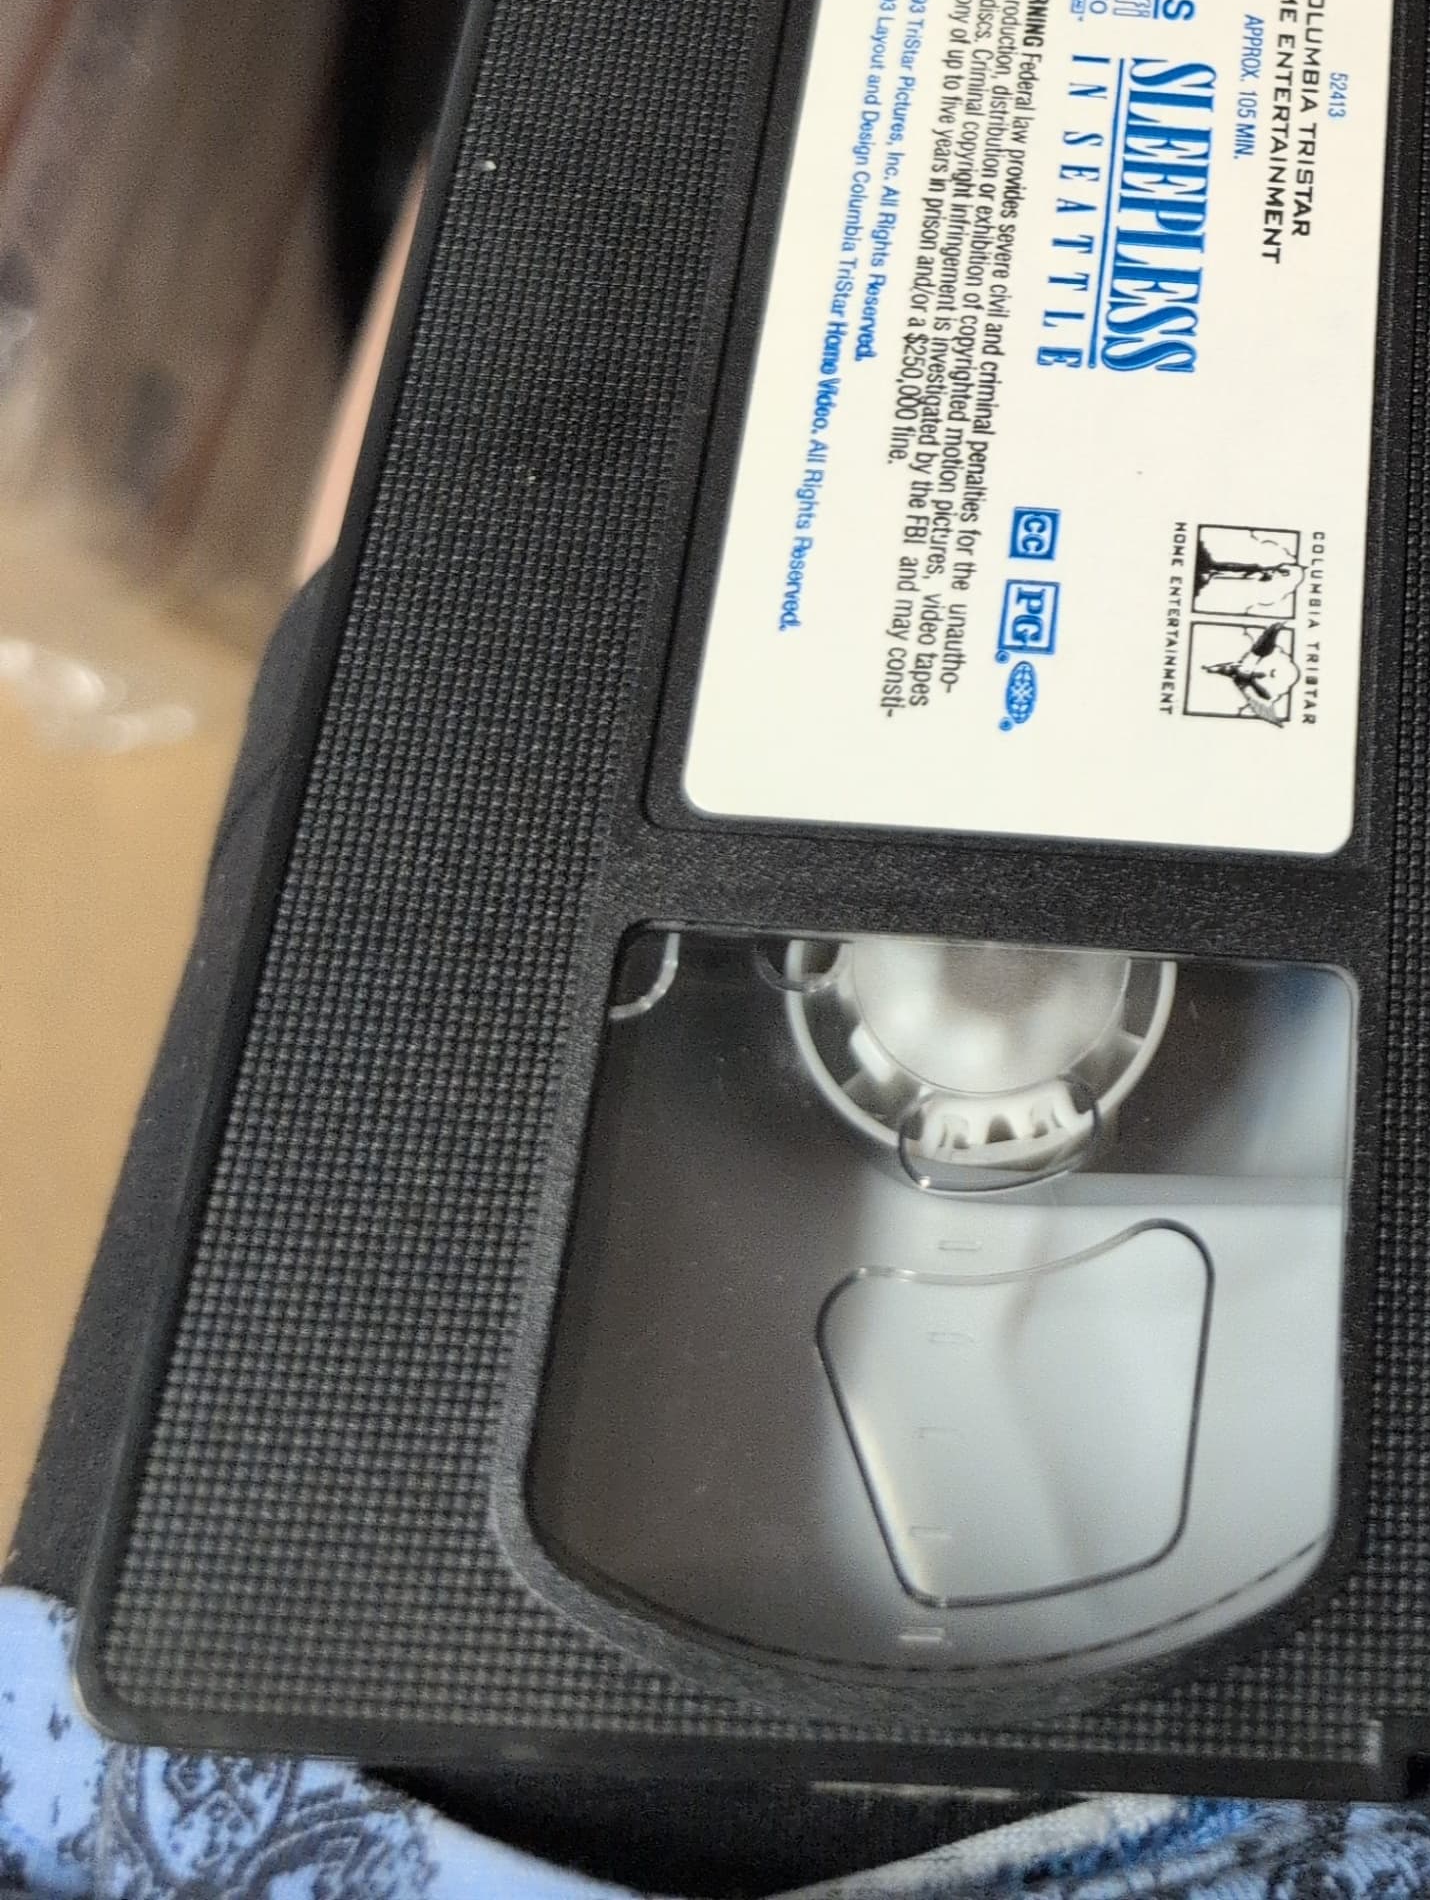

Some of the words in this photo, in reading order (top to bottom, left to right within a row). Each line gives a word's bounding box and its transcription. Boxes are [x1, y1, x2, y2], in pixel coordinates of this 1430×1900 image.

[869, 15, 894, 70] Layout
[900, 18, 924, 70] TriStar
[940, 48, 964, 69] up
[948, 27, 971, 44] of
[1240, 13, 1264, 81] APPROX.
[863, 73, 881, 105] and
[941, 74, 965, 90] to
[963, 48, 994, 116] Criminal
[1014, 52, 1042, 111] Federal
[1068, 54, 1110, 98] IN
[1327, 71, 1348, 118] 52413
[885, 75, 916, 145] Pictures,
[937, 95, 963, 124] five
[980, 84, 1013, 178] distribution
[1009, 115, 1034, 144] law
[1236, 91, 1258, 118] 105
[851, 109, 880, 165] Design
[930, 128, 953, 173] years
[948, 120, 979, 198] copyright
[1233, 122, 1256, 159] MIN.
[1261, 33, 1295, 264] ENTERTAINMENT
[883, 151, 905, 180] Inc.
[927, 177, 953, 192] in
[977, 182, 996, 201] or
[999, 148, 1027, 219] provides
[1290, 122, 1317, 236] TRISTAR
[840, 170, 870, 252] Columbia
[879, 185, 900, 207] All
[1099, 57, 1216, 373] SLEEPLESS
[870, 211, 897, 267] Rights
[918, 196, 947, 253] prison
[963, 204, 997, 286] exhibition
[991, 223, 1016, 279] severe
[1036, 130, 1103, 368] SEATTLE
[909, 254, 937, 313] and/or
[931, 202, 974, 311] infringement
[829, 257, 857, 318] TriStar
[961, 292, 985, 310] of
[986, 283, 1012, 318] civil
[854, 273, 886, 361] Reserved.
[906, 316, 926, 327] a
[932, 316, 957, 331] is
[981, 322, 1005, 356] and
[819, 321, 848, 375] Home
[893, 331, 930, 420] $250,000
[939, 314, 978, 422] copyrighted
[811, 377, 839, 434] Video.
[912, 335, 956, 446] investigated
[971, 360, 1002, 435] criminal
[806, 438, 828, 463] All
[887, 425, 916, 467] fine.
[907, 451, 939, 475] by
[937, 426, 968, 493] motion
[795, 468, 824, 530] Rights
[907, 479, 934, 509] the
[955, 439, 988, 522] penalties
[902, 514, 930, 544] FBI
[921, 498, 958, 579] pictures,
[955, 528, 982, 556] for
[1170, 521, 1187, 566] HOME
[778, 535, 812, 631] Reserved.
[896, 555, 920, 592] and
[950, 561, 977, 591] the
[1307, 530, 1325, 628] COLUMBIA
[884, 598, 913, 641] may
[916, 593, 946, 646] video
[1158, 575, 1182, 715] ENTERTAINMENT
[938, 603, 967, 693] unautho-
[879, 646, 910, 717] consti-
[902, 651, 938, 707] tapes
[1301, 641, 1319, 724] TRISTAR
